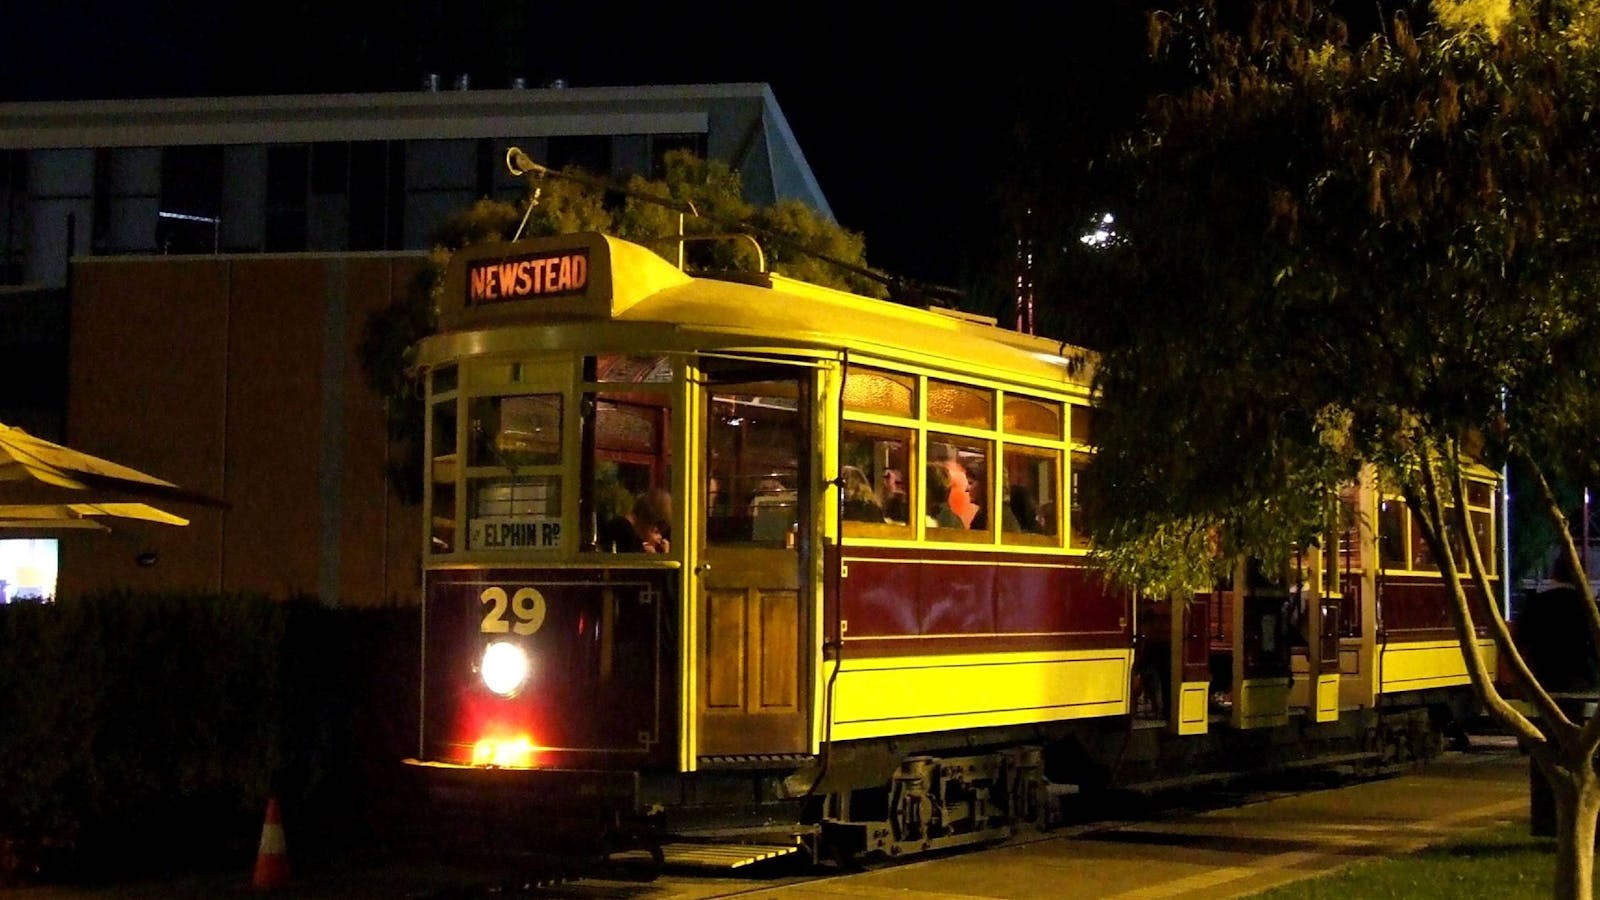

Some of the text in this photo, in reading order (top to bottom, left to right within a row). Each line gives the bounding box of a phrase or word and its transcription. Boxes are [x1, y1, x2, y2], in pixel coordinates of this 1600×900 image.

[471, 255, 587, 299] NEWSTEAD
[484, 523, 537, 547] ELPHIN
[480, 586, 547, 636] 29
